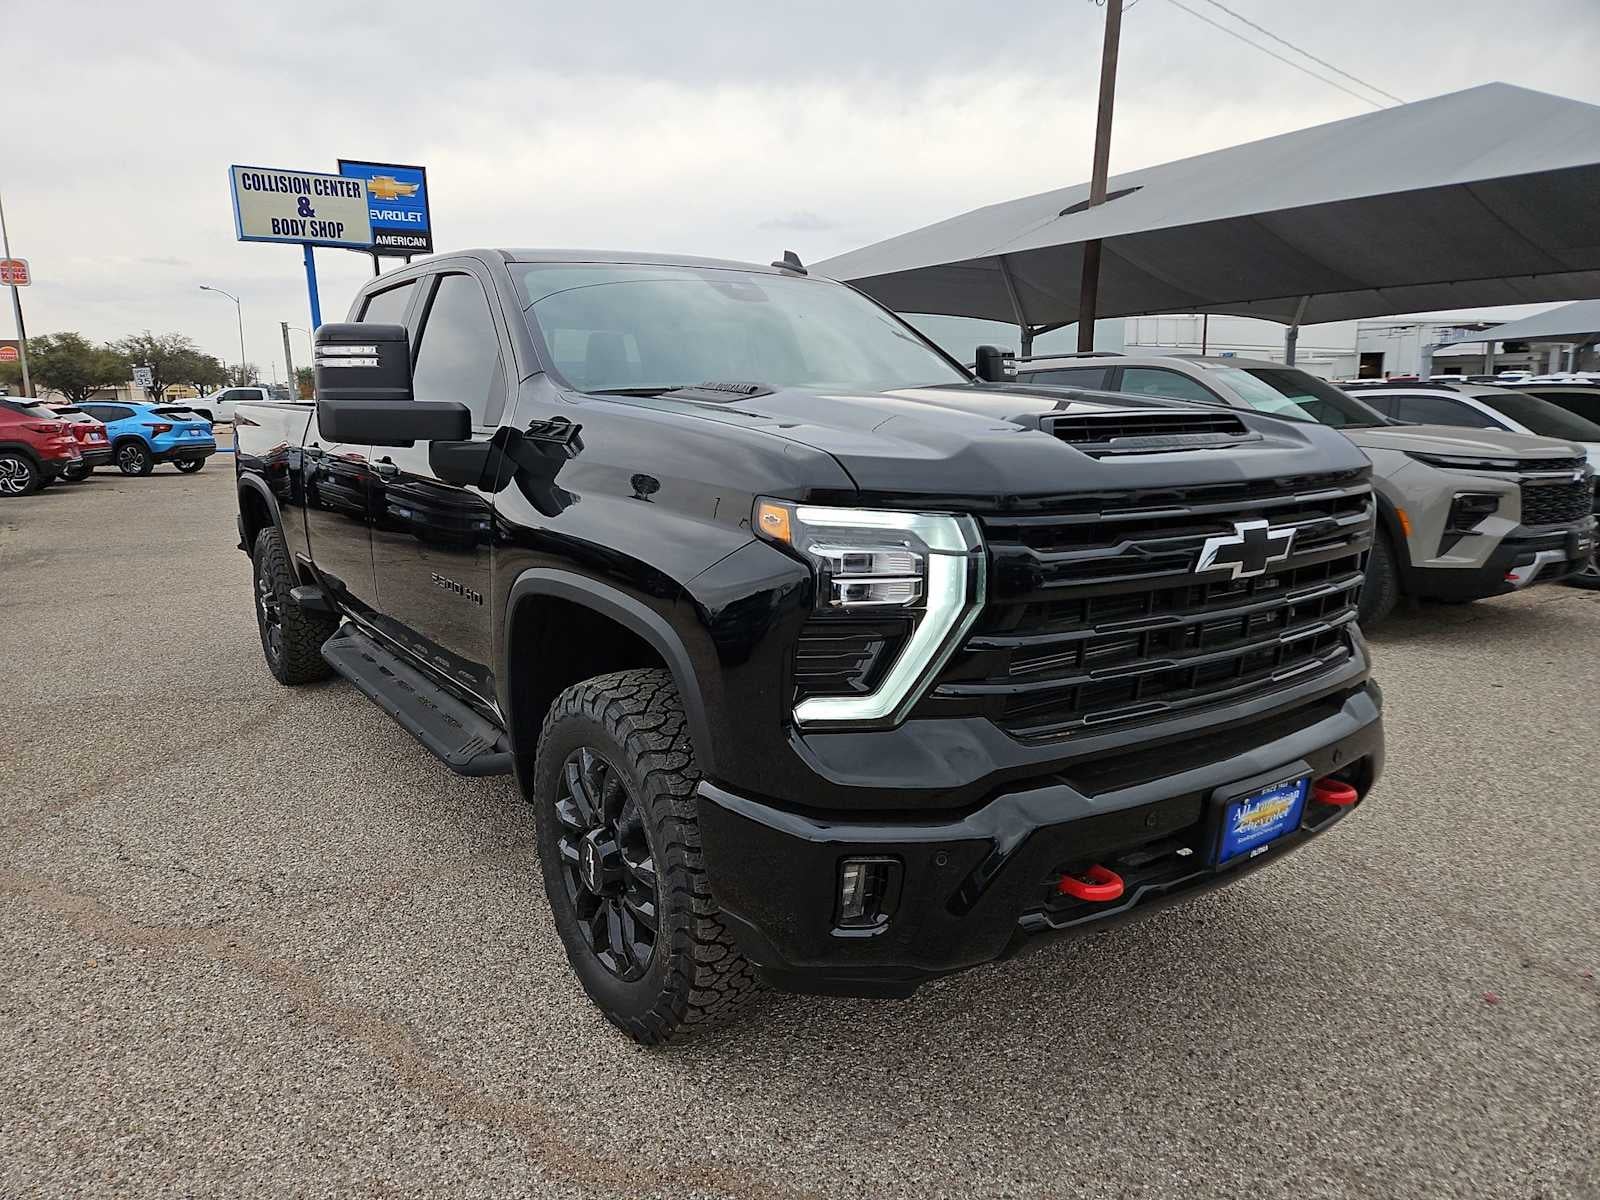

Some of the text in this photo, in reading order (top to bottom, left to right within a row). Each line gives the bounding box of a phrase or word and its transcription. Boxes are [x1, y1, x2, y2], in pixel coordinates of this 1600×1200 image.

[242, 173, 361, 198] COLLISION CENTER
[297, 196, 315, 218] &
[370, 209, 423, 223] EVROLET
[271, 218, 344, 239] BODY SHOP
[375, 235, 427, 247] AMERICAN
[1, 272, 28, 280] KNG
[138, 378, 151, 386] 35
